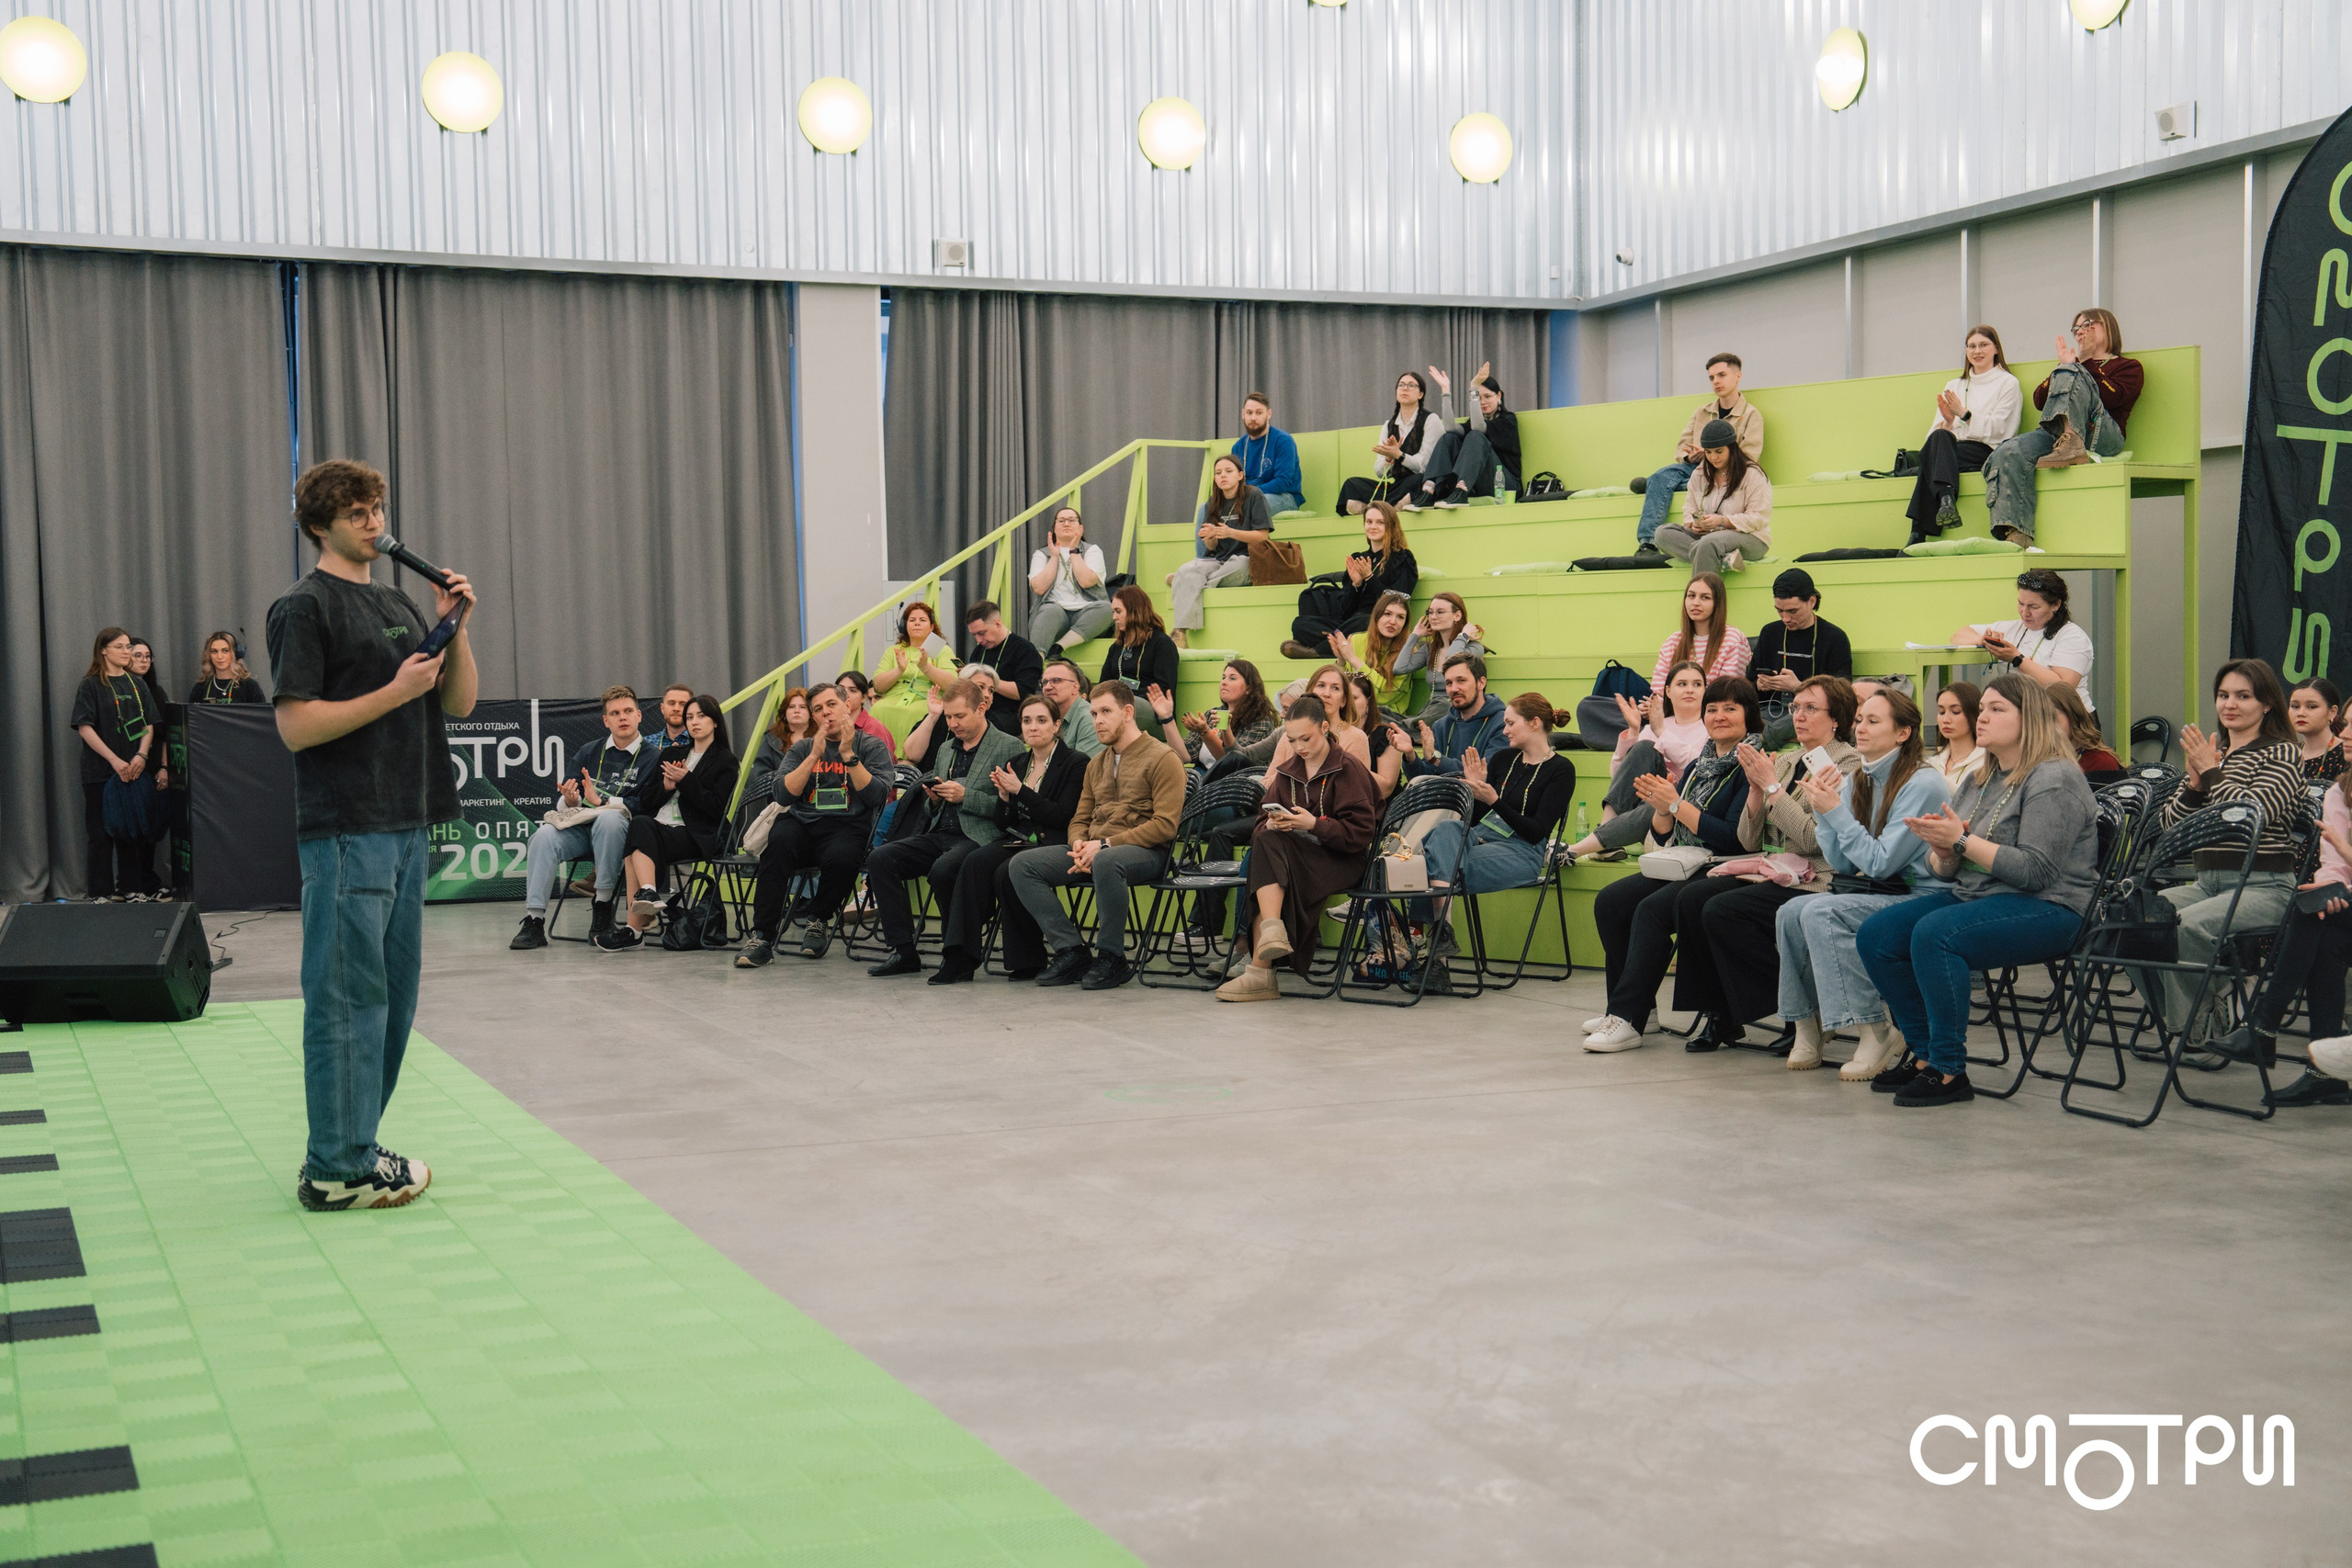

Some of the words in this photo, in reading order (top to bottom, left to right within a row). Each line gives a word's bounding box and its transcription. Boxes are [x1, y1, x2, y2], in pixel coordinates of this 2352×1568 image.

[445, 723, 483, 731] ЕТСКОГО
[483, 722, 520, 731] ОТДЫХА
[514, 796, 551, 806] КРЕАТИВ
[475, 819, 545, 840] ОПЯ
[440, 841, 528, 881] 202
[1374, 967, 1411, 981] КАНЬ
